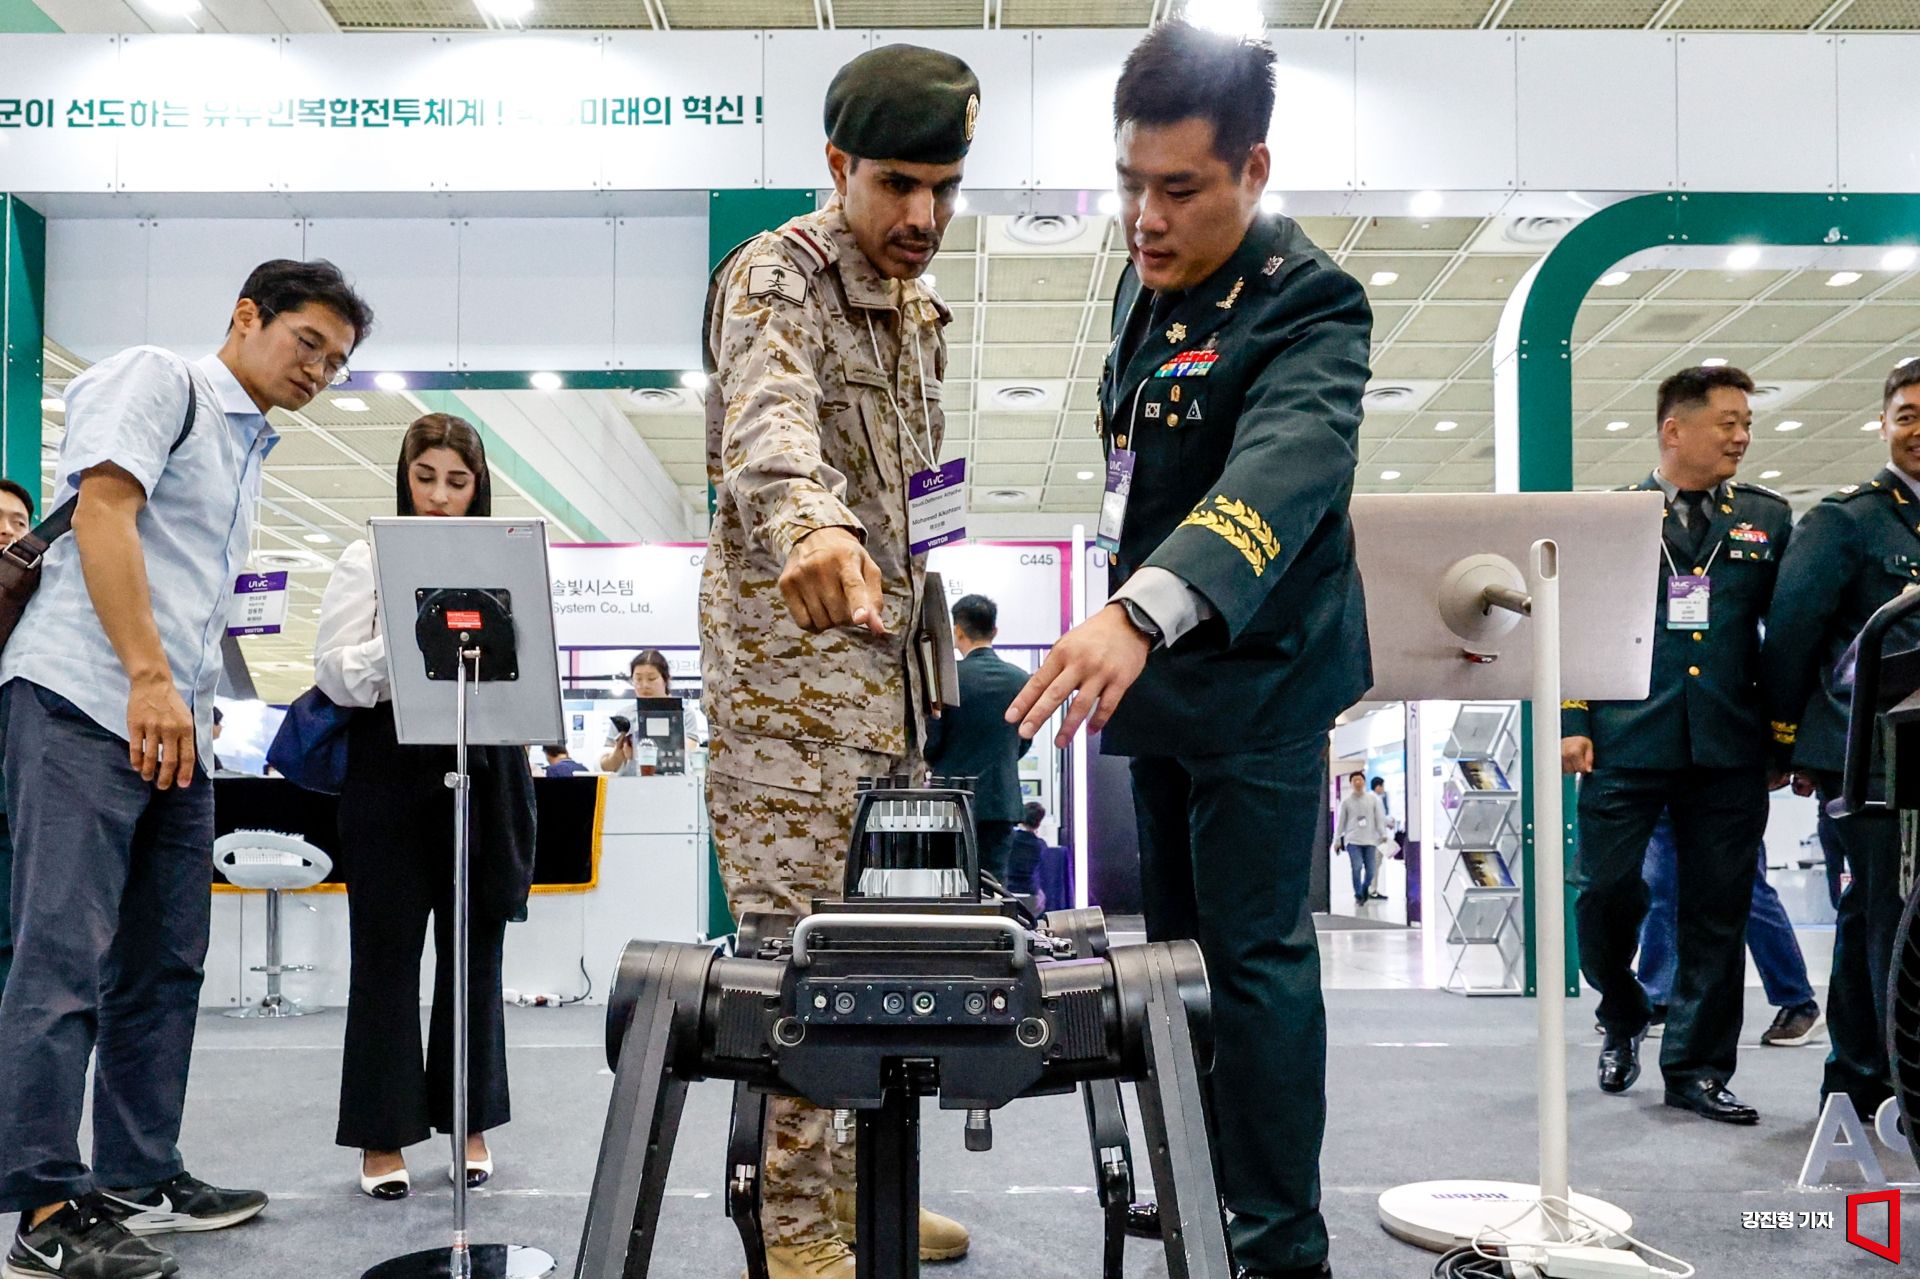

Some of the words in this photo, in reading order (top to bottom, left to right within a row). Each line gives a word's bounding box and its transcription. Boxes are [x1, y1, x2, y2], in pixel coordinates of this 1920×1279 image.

[66, 98, 190, 128] 선도하는
[682, 96, 744, 125] 혁신
[1020, 554, 1054, 566] C445
[552, 579, 634, 597] 솔빛시스템
[554, 601, 596, 615] System
[630, 602, 653, 614] Ltd.
